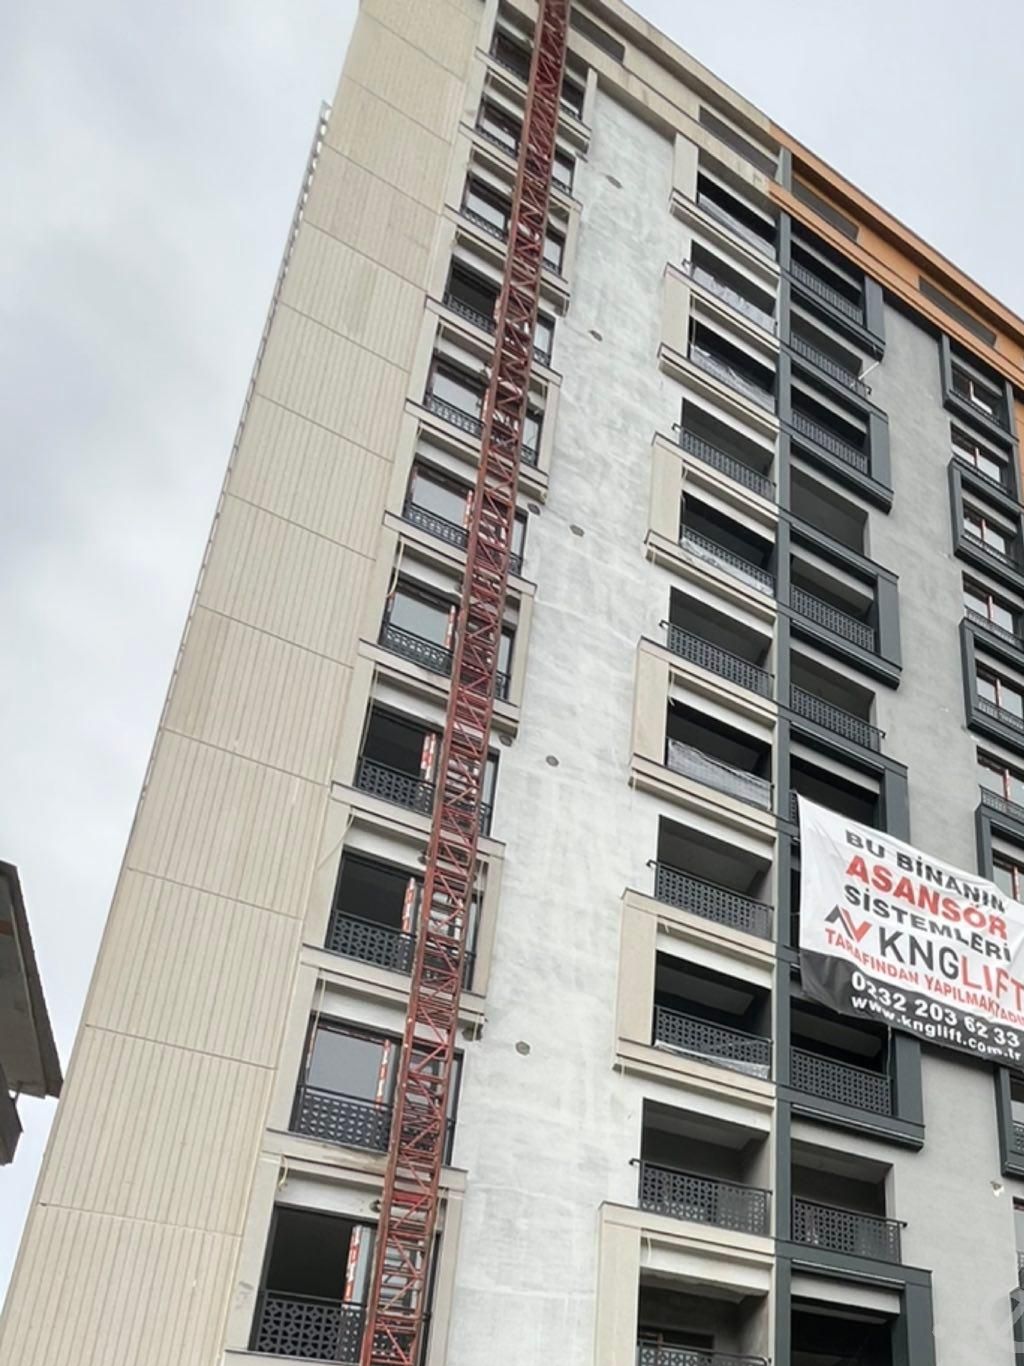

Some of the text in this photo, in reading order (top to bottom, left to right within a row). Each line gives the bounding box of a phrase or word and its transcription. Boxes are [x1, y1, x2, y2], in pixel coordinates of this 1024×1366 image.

[845, 830, 1006, 914] BU BİNANIN
[846, 855, 1008, 940] ASANSÖR
[825, 927, 919, 985] TARAFINDAN
[844, 884, 1012, 962] SİSTEMLERİ
[851, 971, 1021, 1048] 0232 203 62 33
[851, 996, 1022, 1061] www.knglift.com.tr
